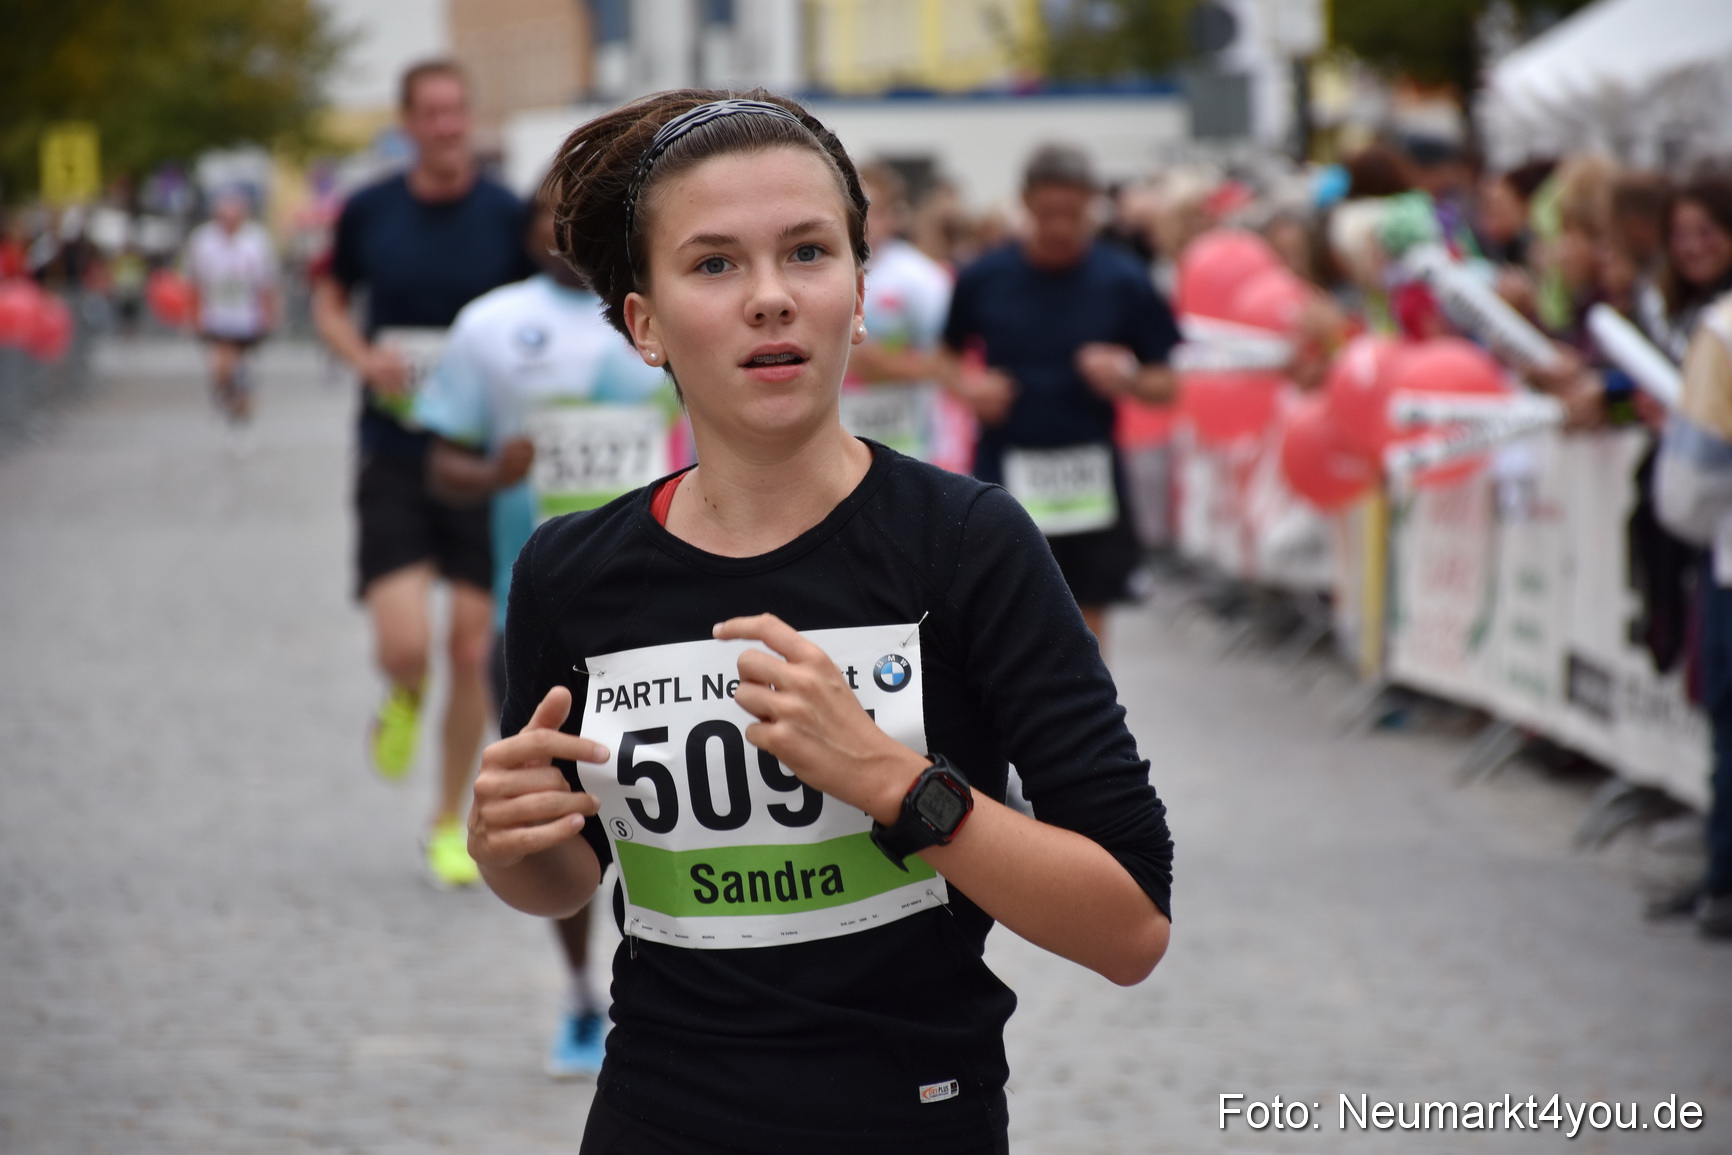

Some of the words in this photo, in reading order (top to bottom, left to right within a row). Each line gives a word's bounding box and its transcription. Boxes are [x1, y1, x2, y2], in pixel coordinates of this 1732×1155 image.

[876, 654, 909, 669] BMW
[595, 677, 691, 713] PARTL
[616, 708, 876, 834] 509
[615, 820, 628, 837] S
[689, 860, 845, 904] Sandra
